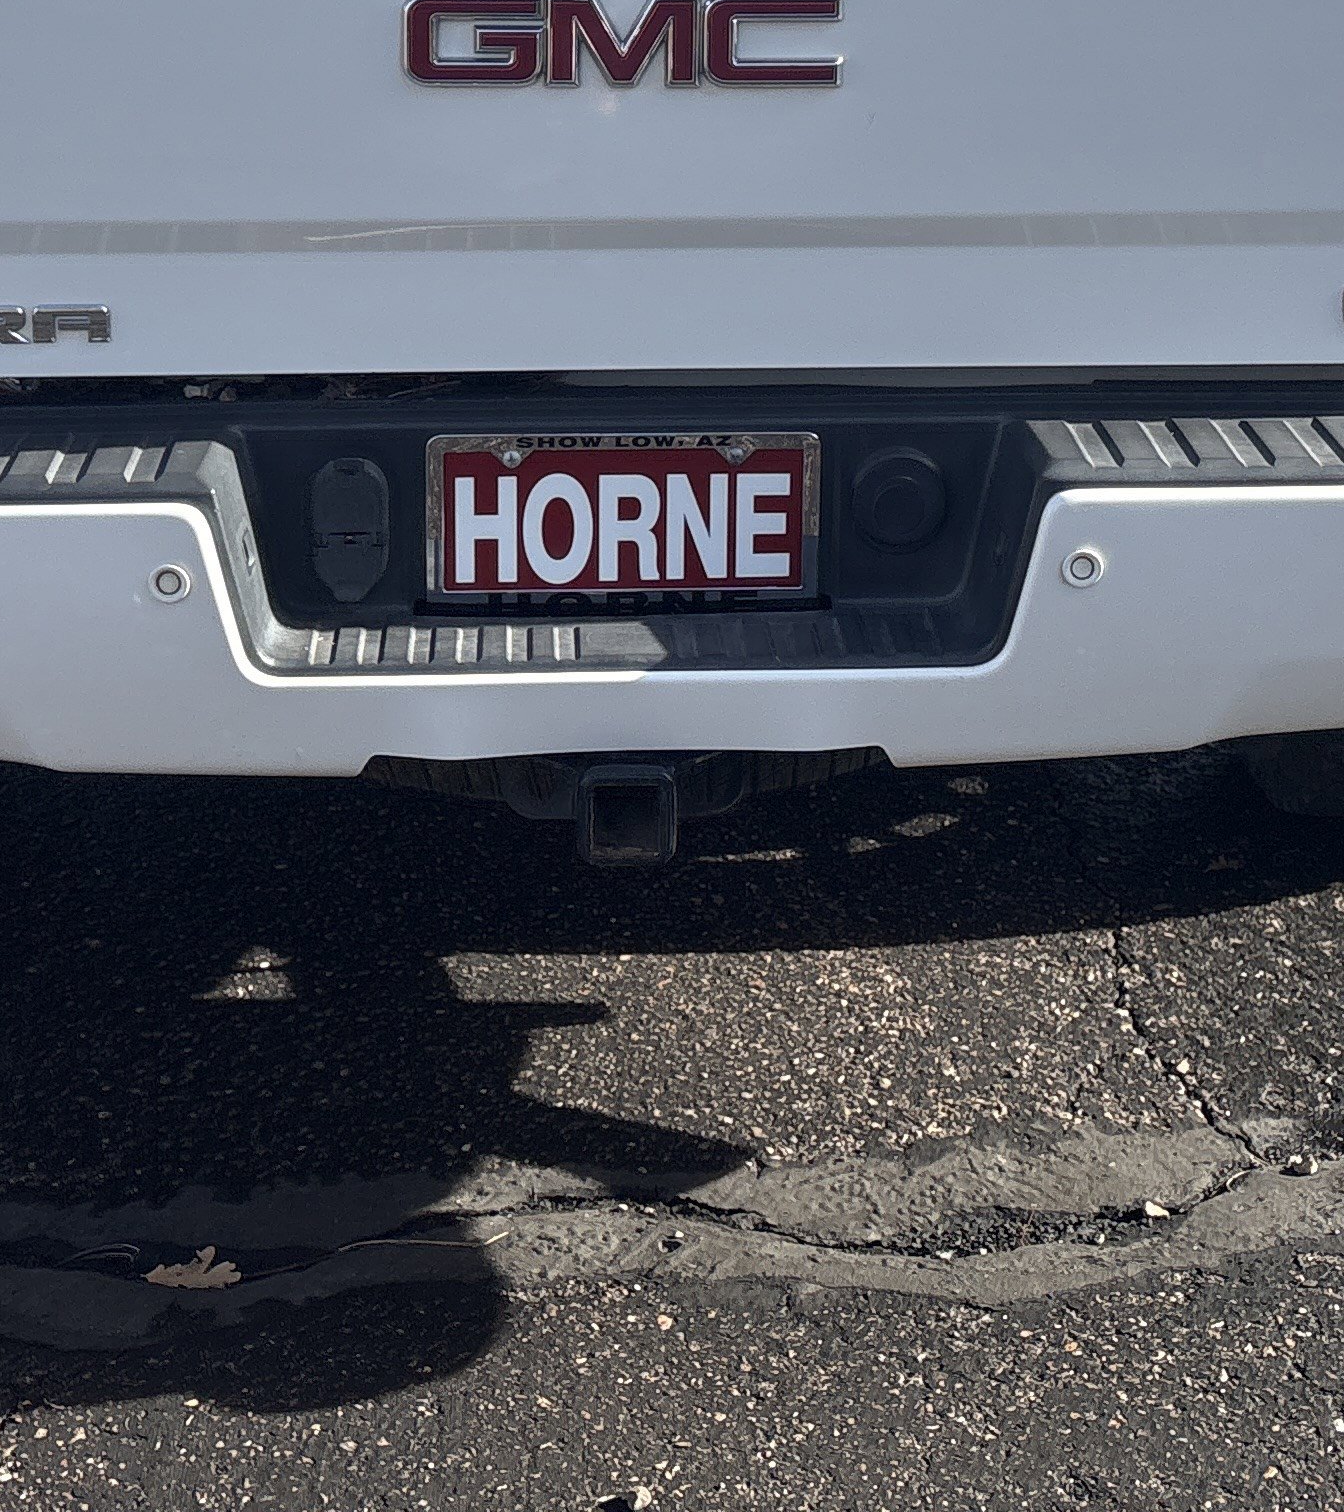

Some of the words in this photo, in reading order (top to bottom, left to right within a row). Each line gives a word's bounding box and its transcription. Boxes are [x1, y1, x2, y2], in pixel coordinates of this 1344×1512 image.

[516, 436, 602, 449] SHOW
[696, 435, 733, 448] AZ
[454, 472, 793, 585] HORNE
